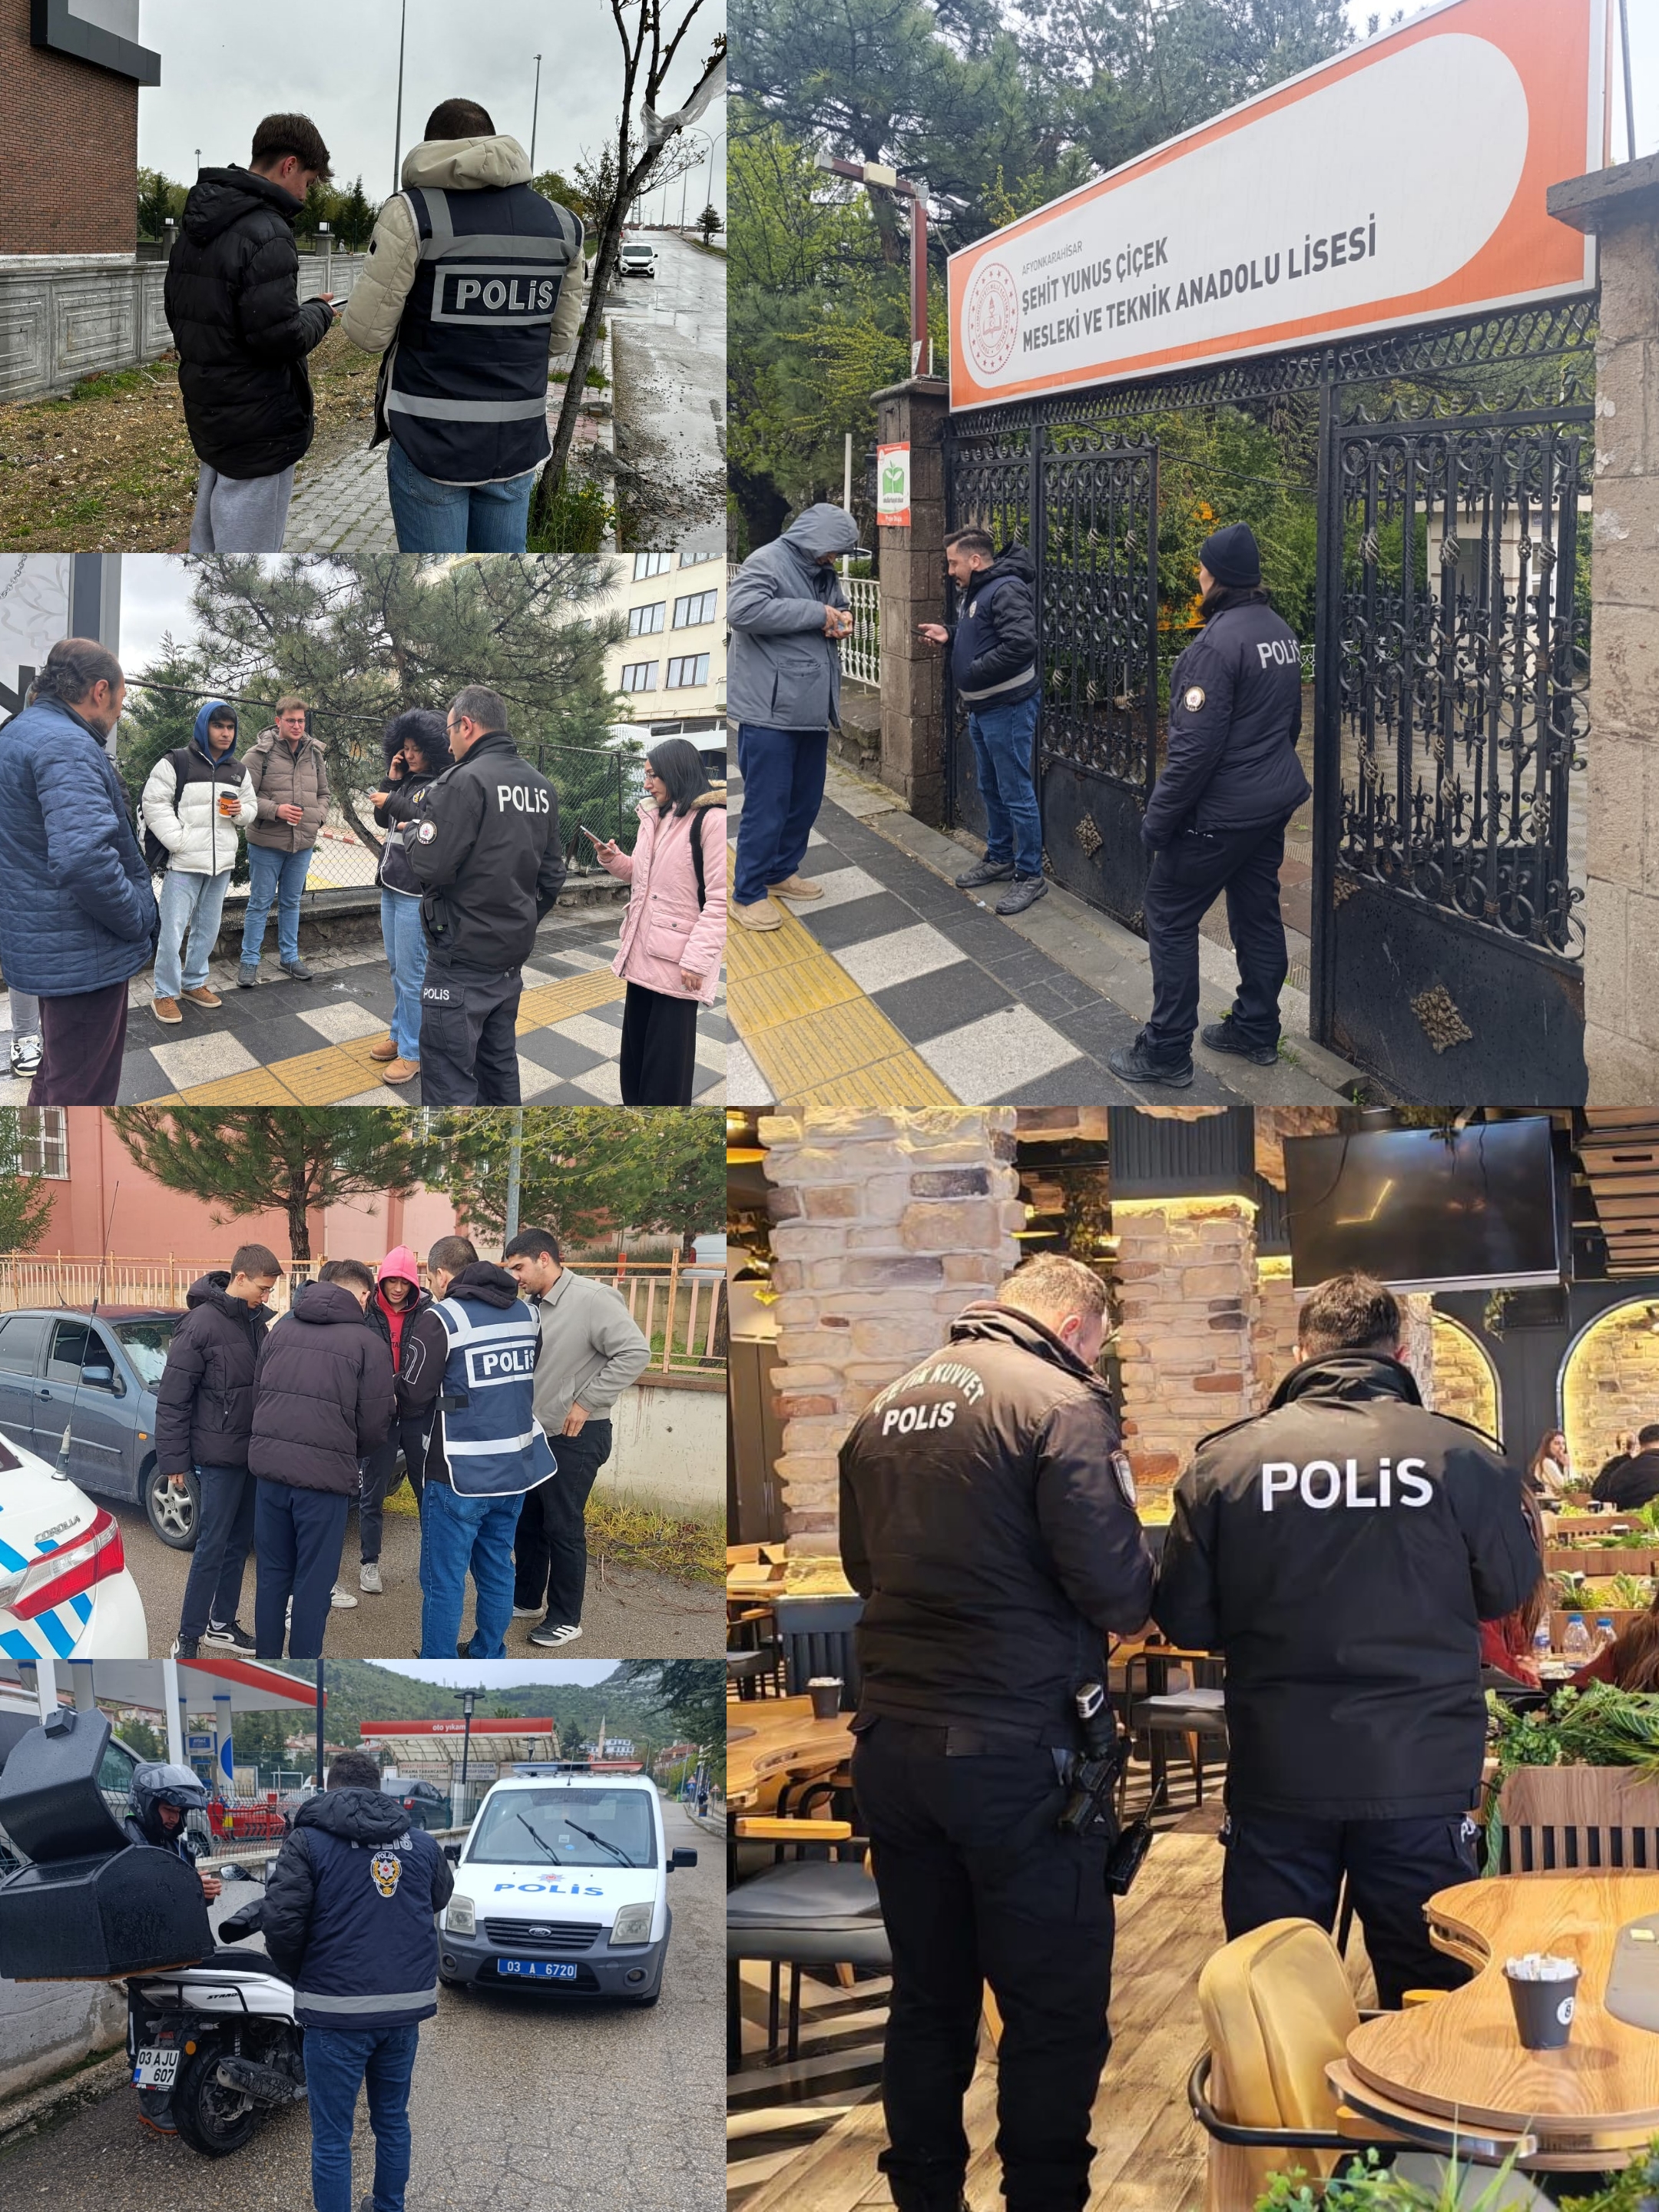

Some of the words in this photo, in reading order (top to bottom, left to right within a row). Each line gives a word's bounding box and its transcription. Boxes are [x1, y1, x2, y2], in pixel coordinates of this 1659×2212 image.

[1022, 240, 1082, 276] AFYONKARAHİSAR
[1022, 275, 1059, 315] ŞEHİT
[1062, 258, 1111, 298] YUNUS
[1116, 236, 1168, 283] ÇİÇEK
[1083, 307, 1102, 335] VE
[1106, 283, 1171, 329] TEKNİK
[1175, 252, 1280, 311] ANADOLU
[1288, 212, 1376, 280] LİSESİ
[929, 1363, 985, 1406] KUVVET
[507, 1961, 521, 1972] 03
[529, 1962, 535, 1974] A
[545, 1964, 575, 1977] 6720
[138, 2051, 152, 2065] 03
[154, 2051, 177, 2066] AJU
[154, 2068, 174, 2083] 607
